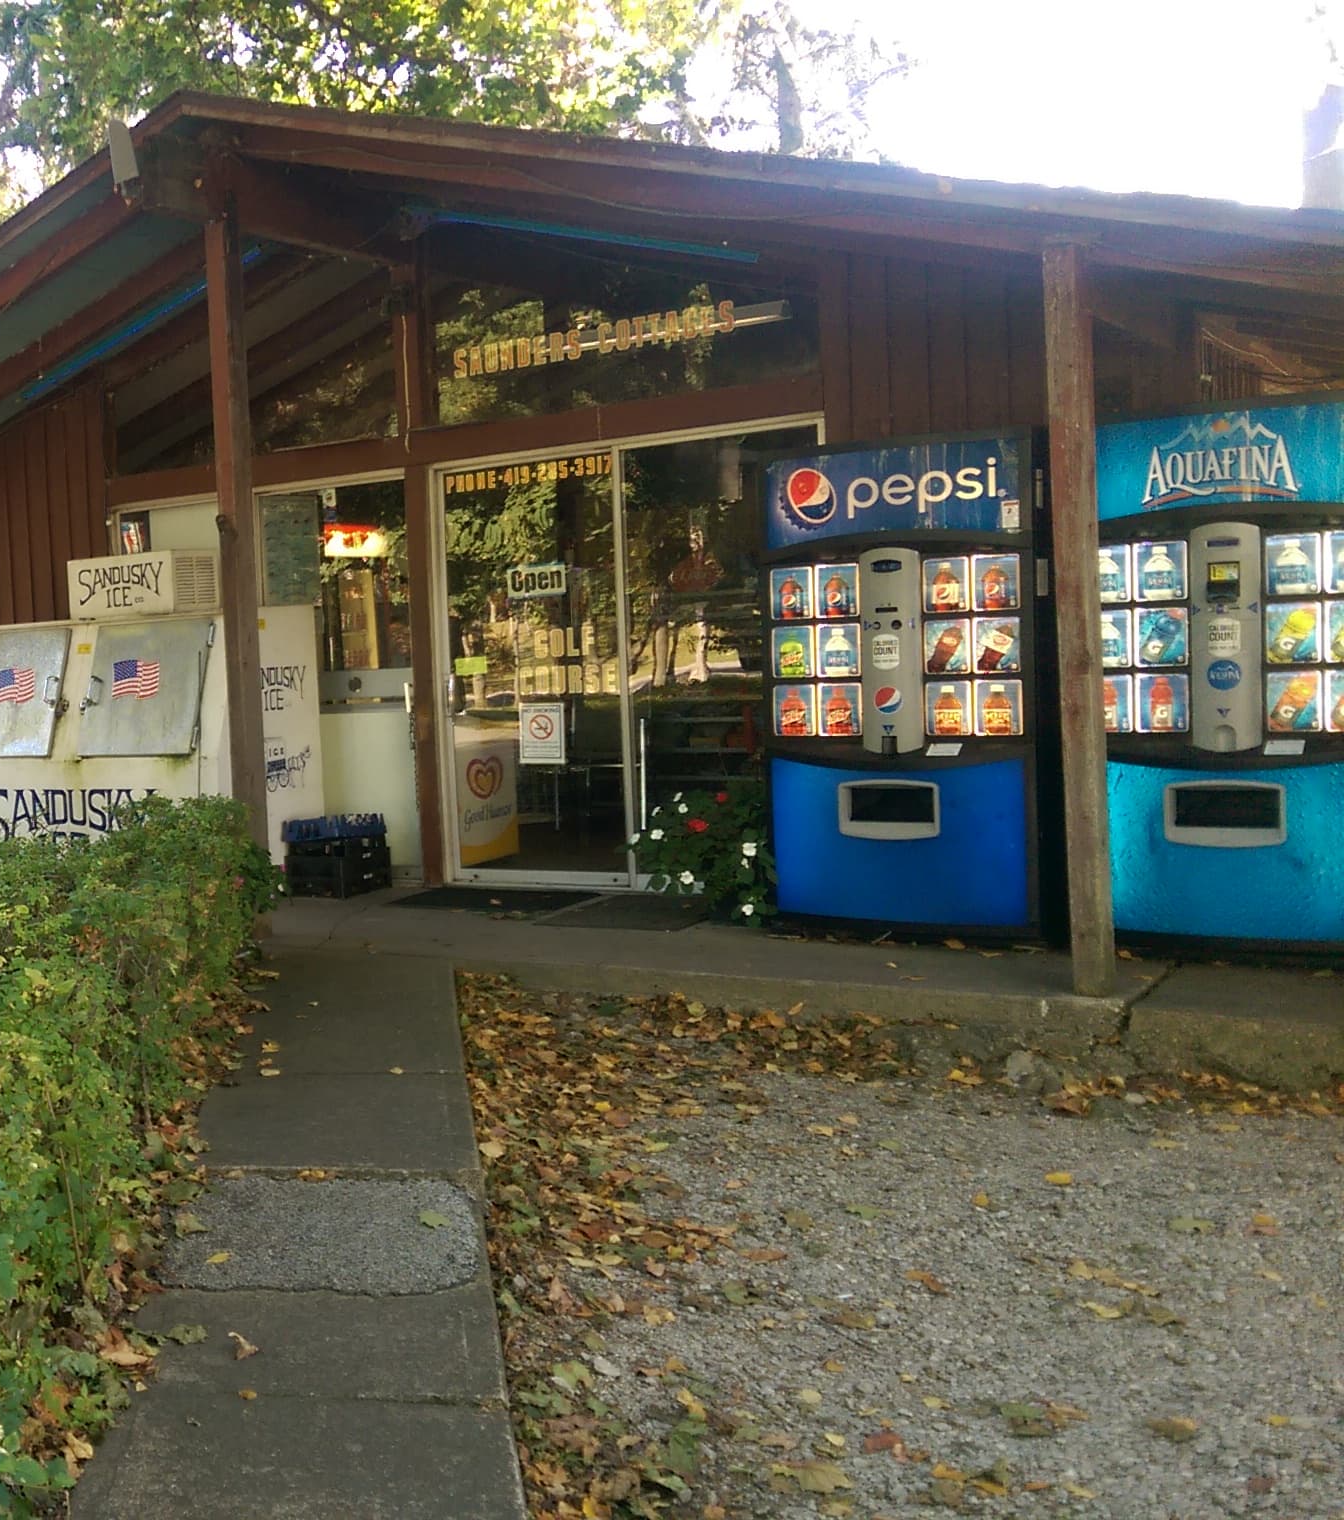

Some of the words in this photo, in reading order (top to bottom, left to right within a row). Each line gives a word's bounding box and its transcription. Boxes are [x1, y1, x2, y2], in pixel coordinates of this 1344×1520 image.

[1142, 434, 1299, 505] AQUAFINA
[847, 456, 997, 519] pepsi
[78, 561, 163, 606] SANDUSKY
[106, 586, 133, 608] ICE
[511, 570, 562, 593] Open
[534, 624, 595, 658] GOLF
[259, 665, 306, 700] NDUSKY
[518, 662, 620, 695] COURSE
[264, 688, 285, 711] ICE
